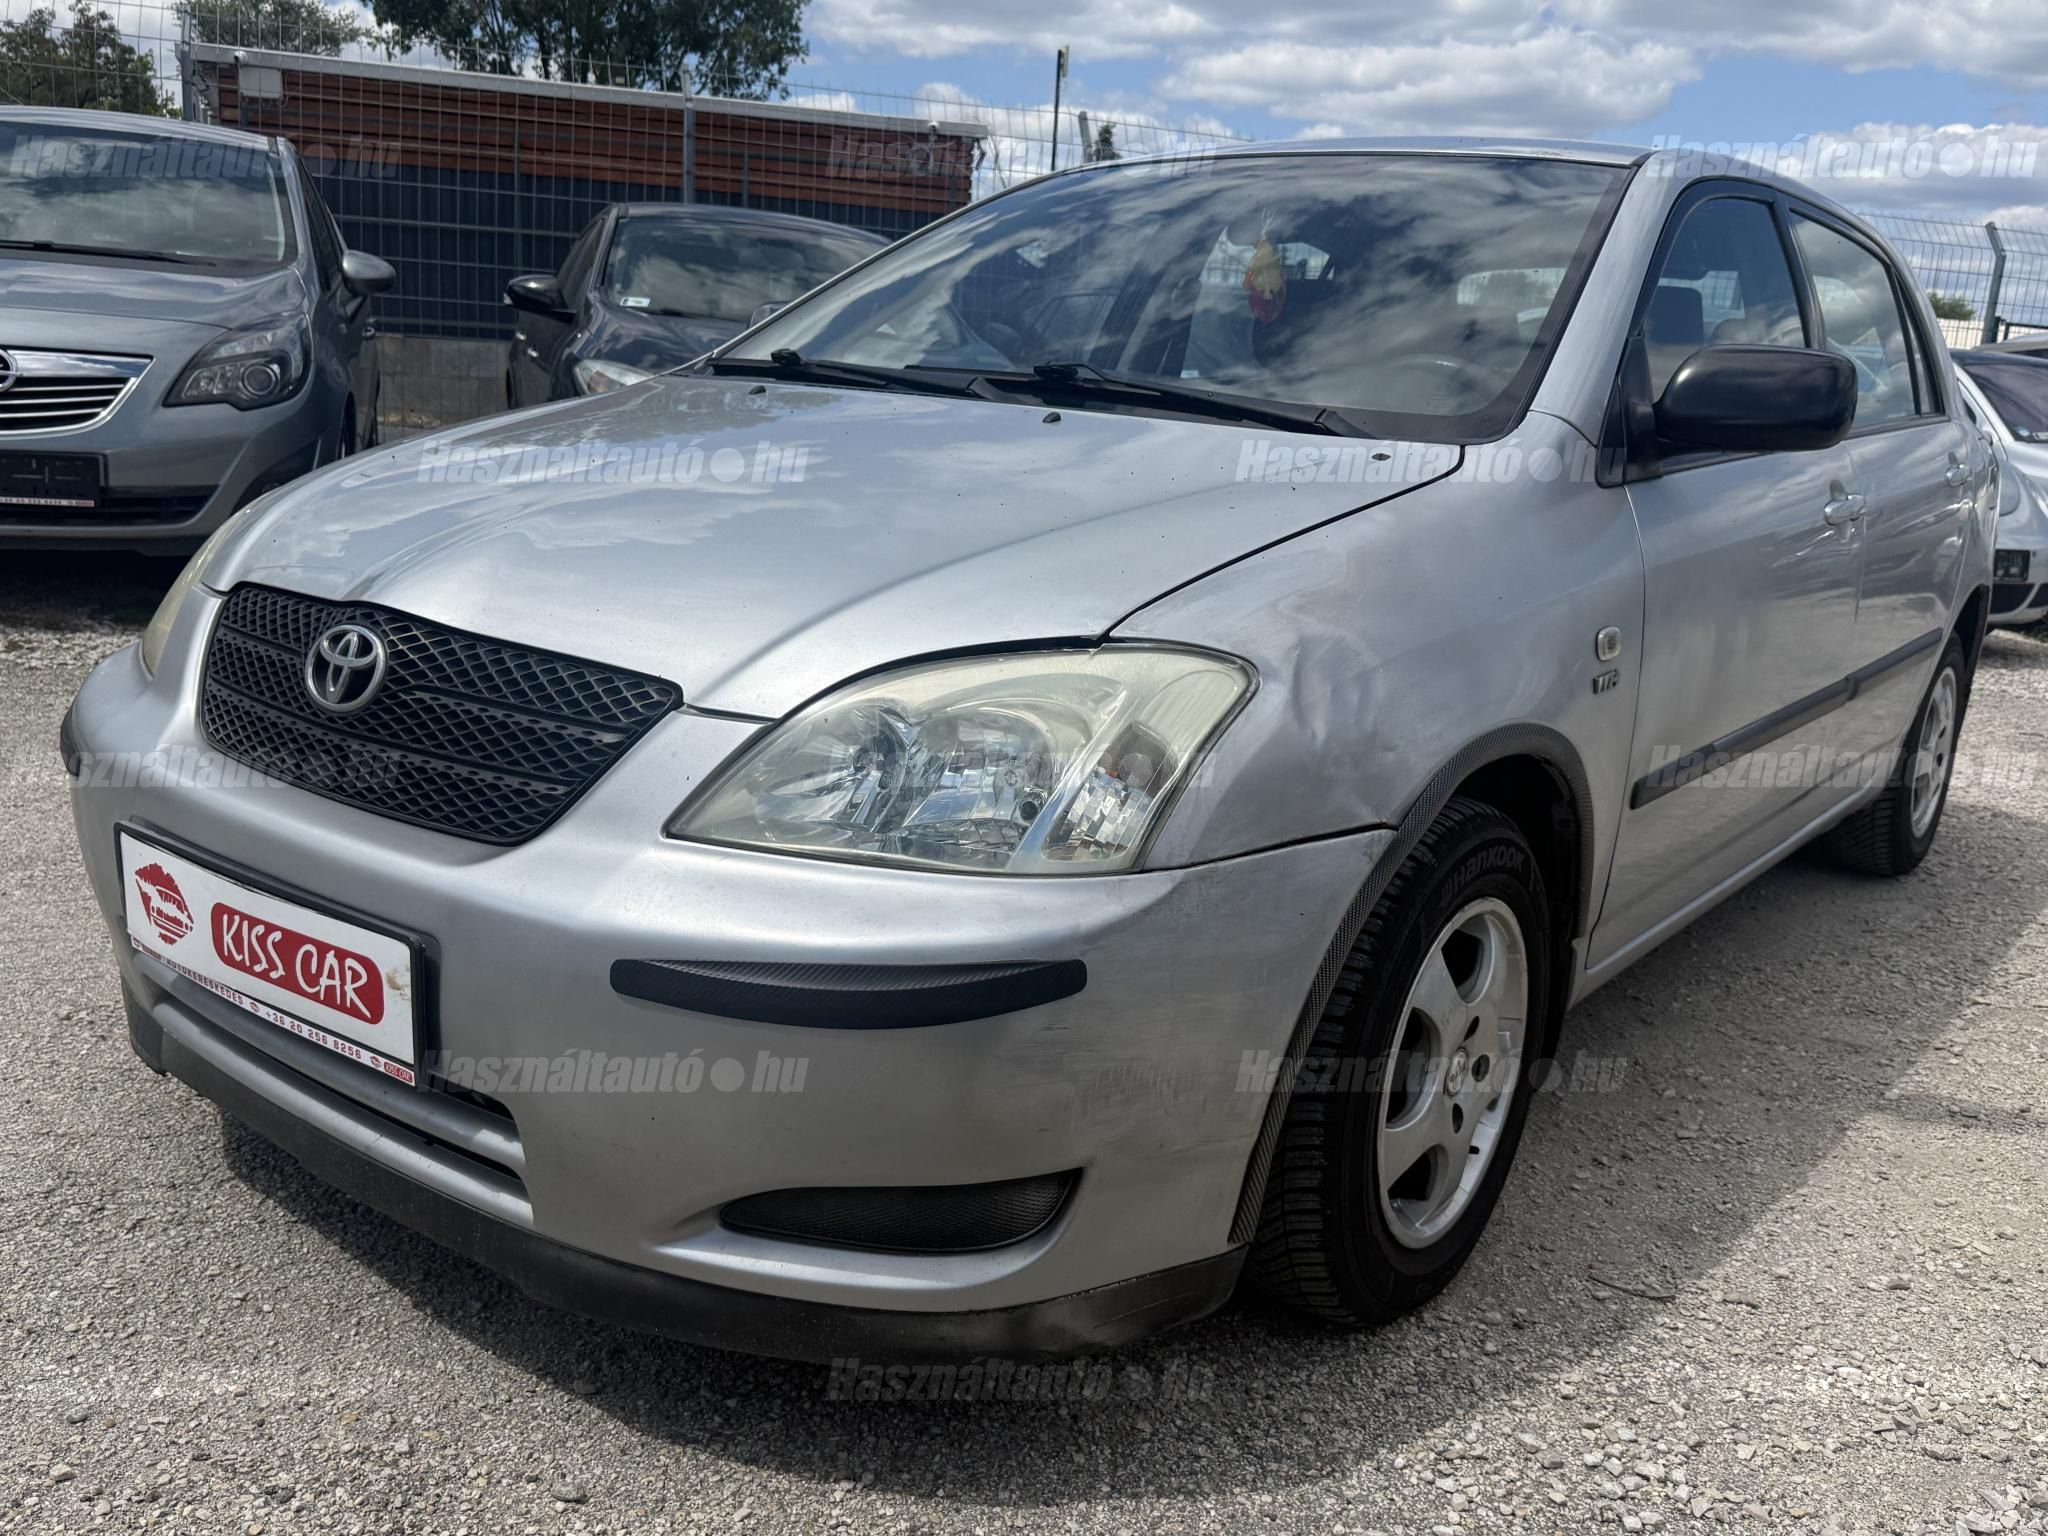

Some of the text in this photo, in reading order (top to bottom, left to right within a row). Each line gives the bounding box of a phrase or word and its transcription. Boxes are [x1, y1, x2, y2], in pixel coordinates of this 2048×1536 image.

[222, 913, 372, 1019] KISS CAR
[265, 1010, 286, 1026] +36
[290, 1020, 303, 1034] 20
[308, 1029, 328, 1045] 256
[333, 1039, 362, 1060] 8256
